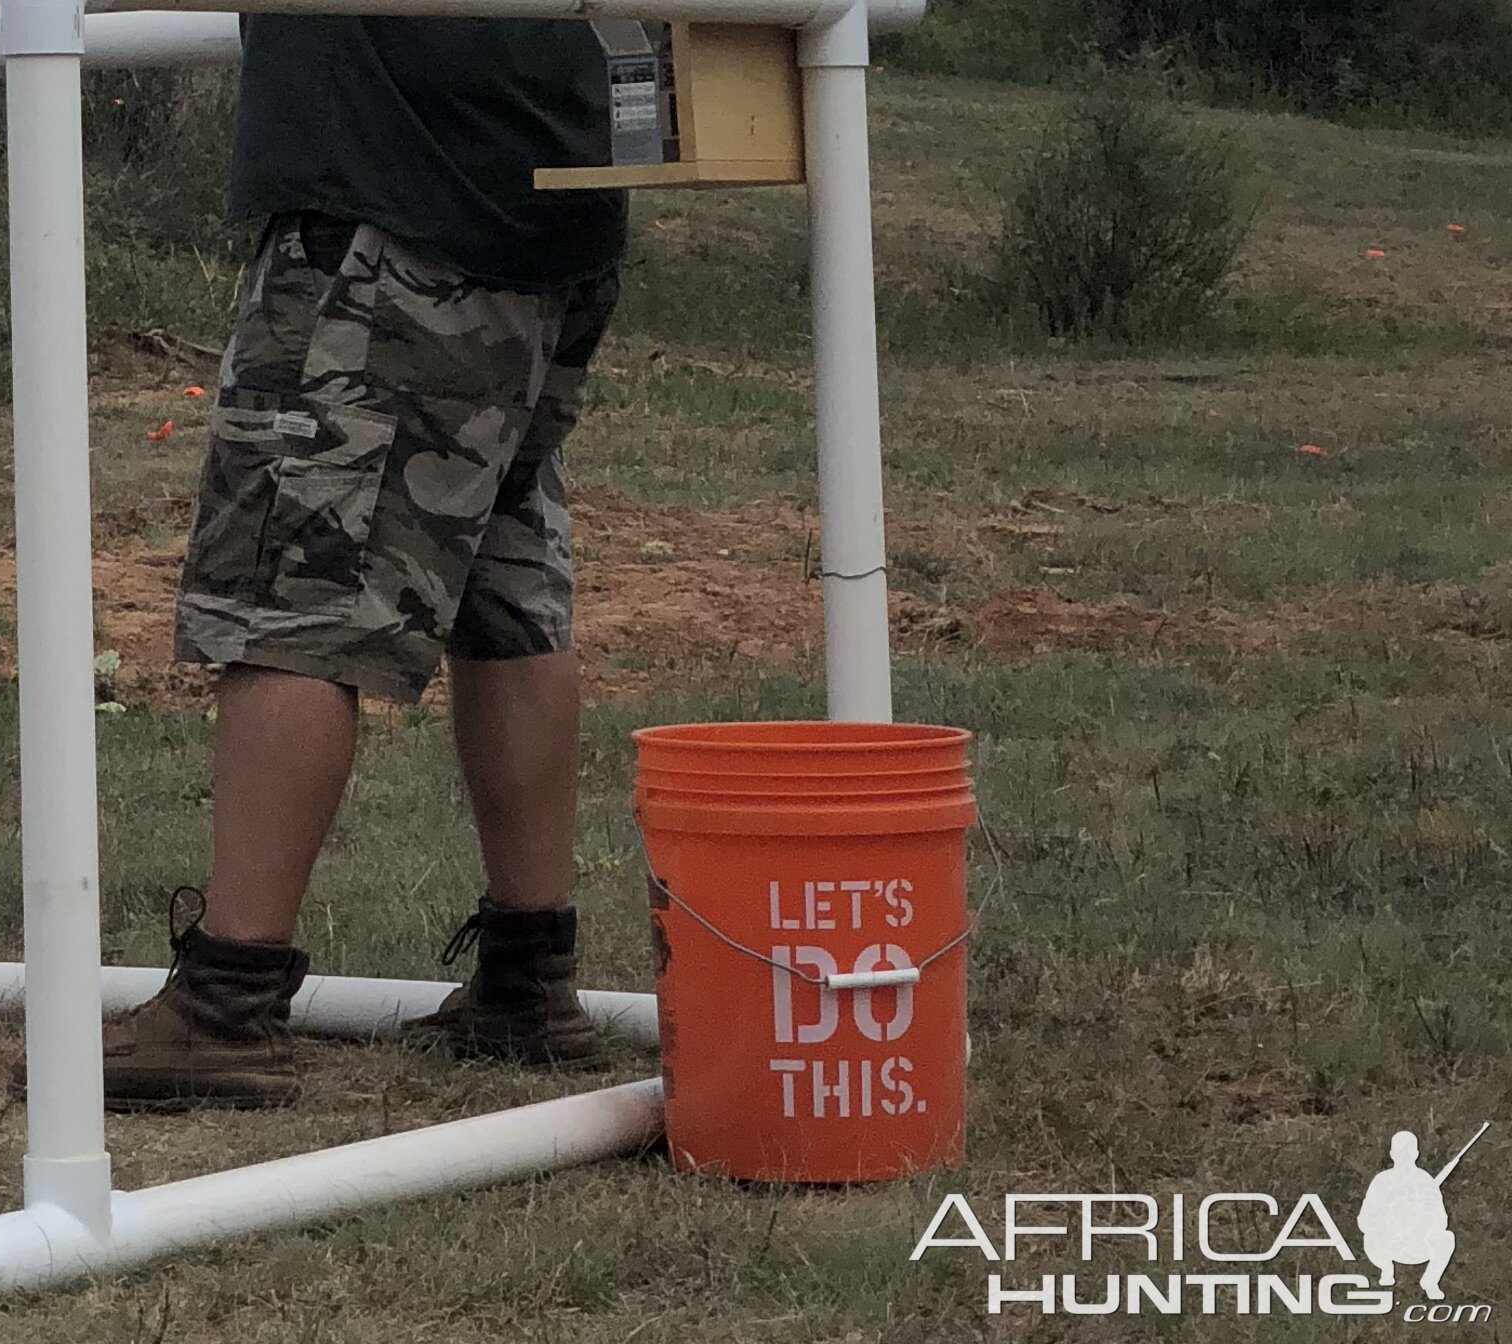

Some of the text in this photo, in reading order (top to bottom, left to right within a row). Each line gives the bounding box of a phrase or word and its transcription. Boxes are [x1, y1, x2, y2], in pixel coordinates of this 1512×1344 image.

[770, 878, 913, 930] LET'S
[772, 943, 914, 1044] DO
[769, 1055, 926, 1118] THIS.
